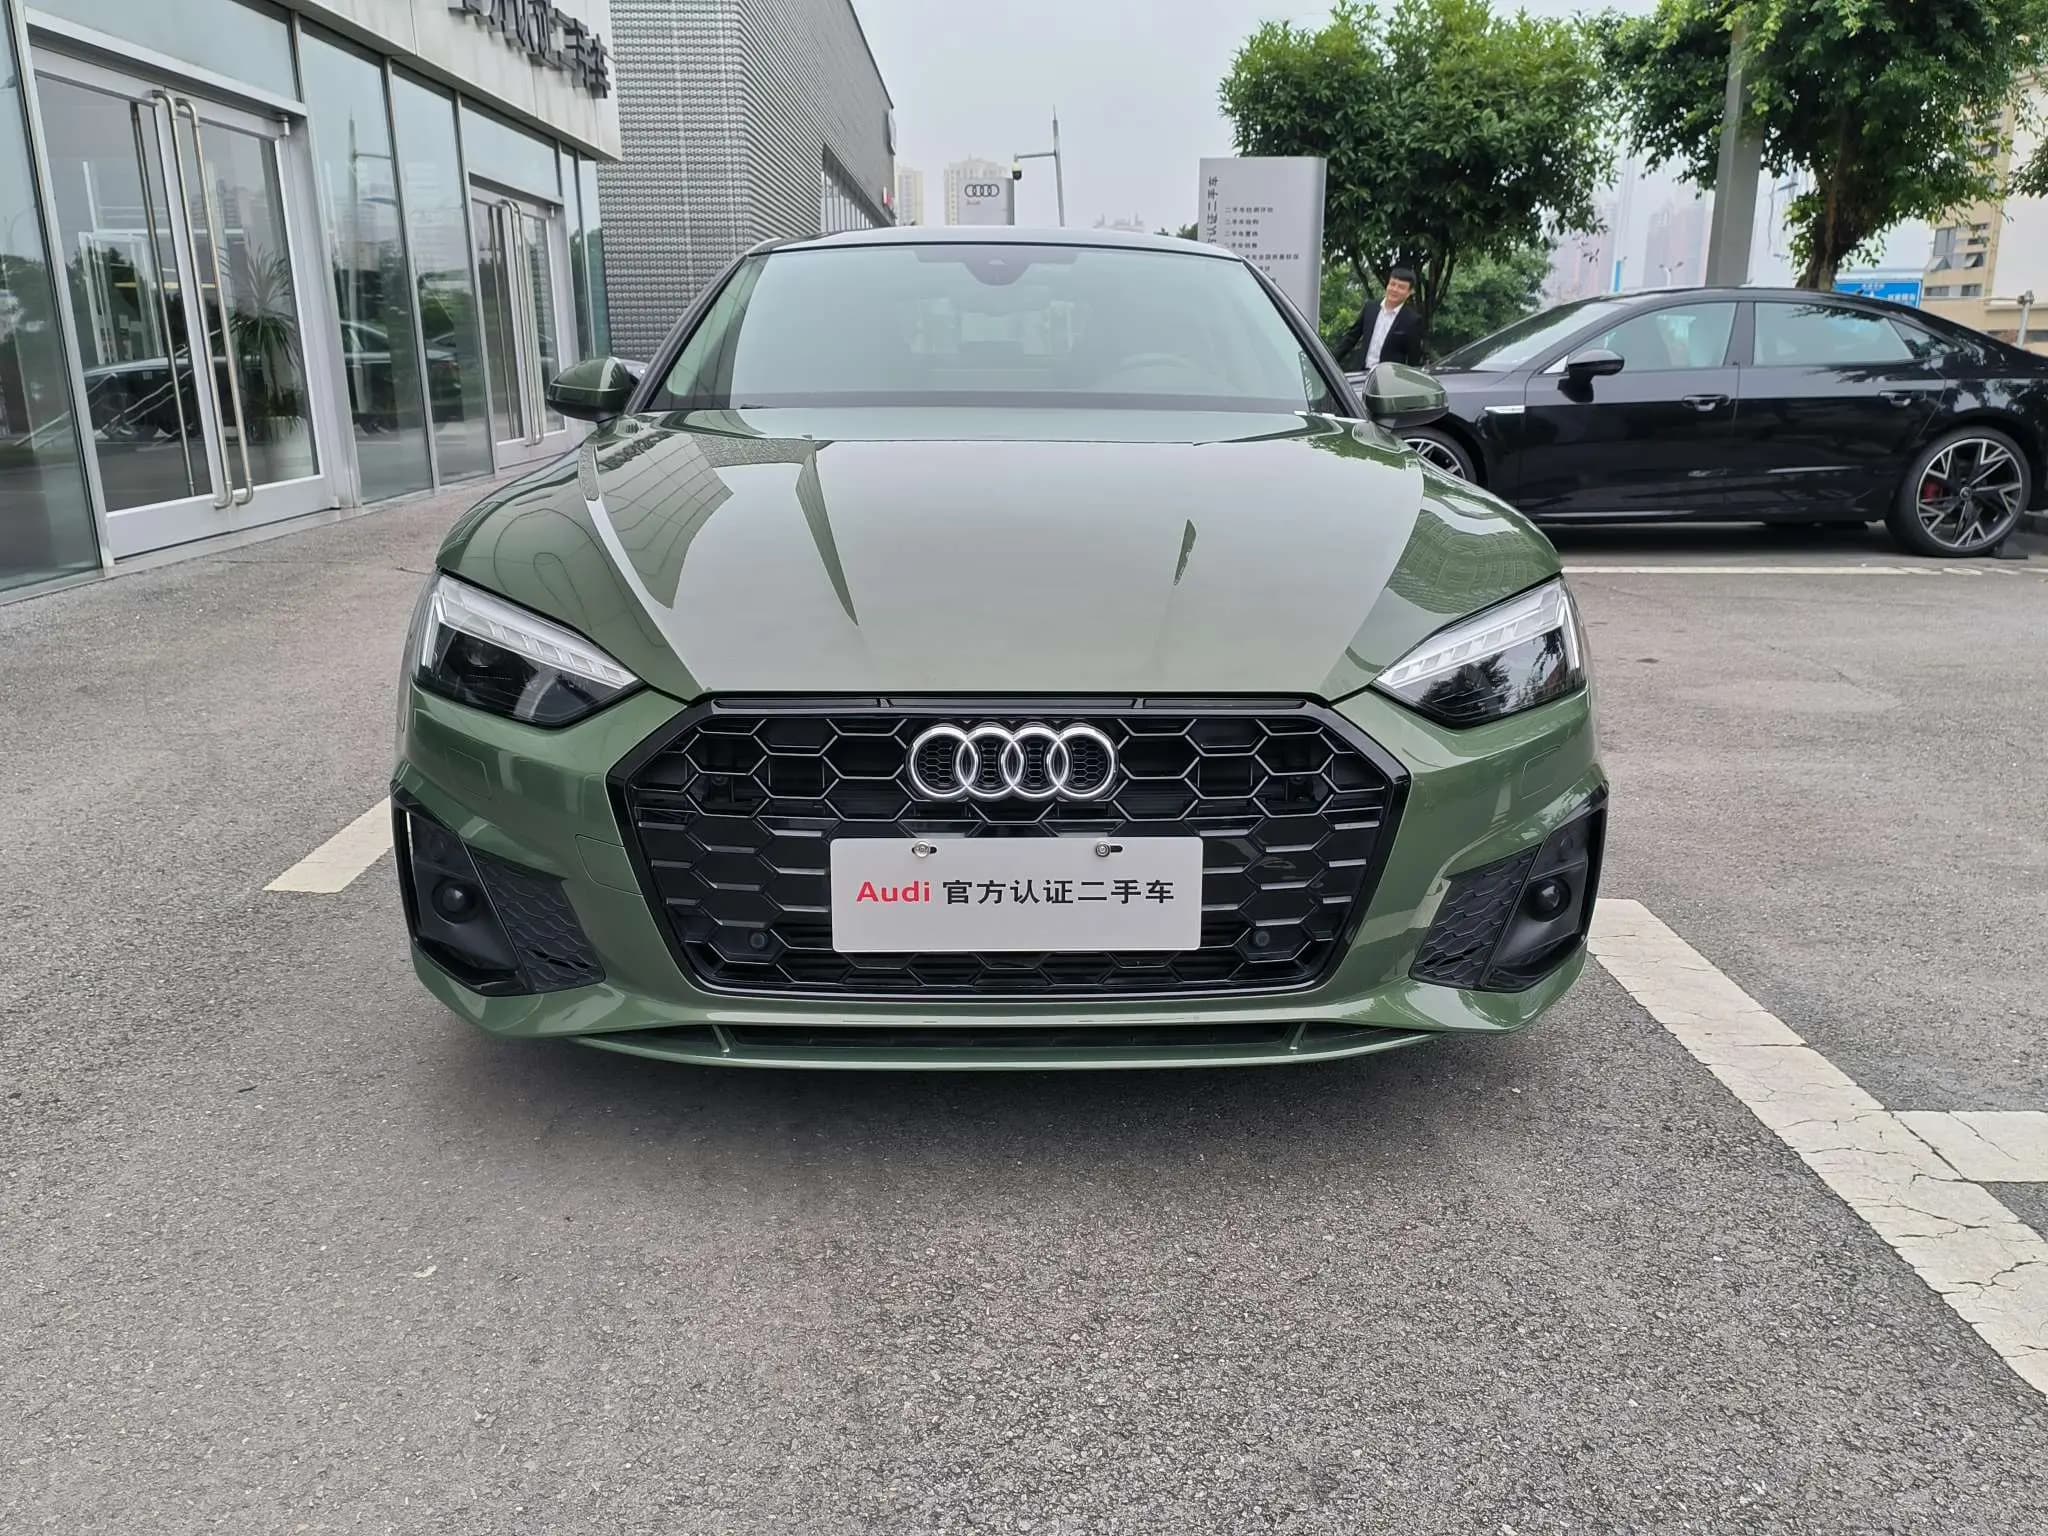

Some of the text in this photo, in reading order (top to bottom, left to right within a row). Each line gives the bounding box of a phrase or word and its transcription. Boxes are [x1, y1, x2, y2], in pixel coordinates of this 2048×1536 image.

[856, 879, 1175, 905] Audi 官方认证二手车
